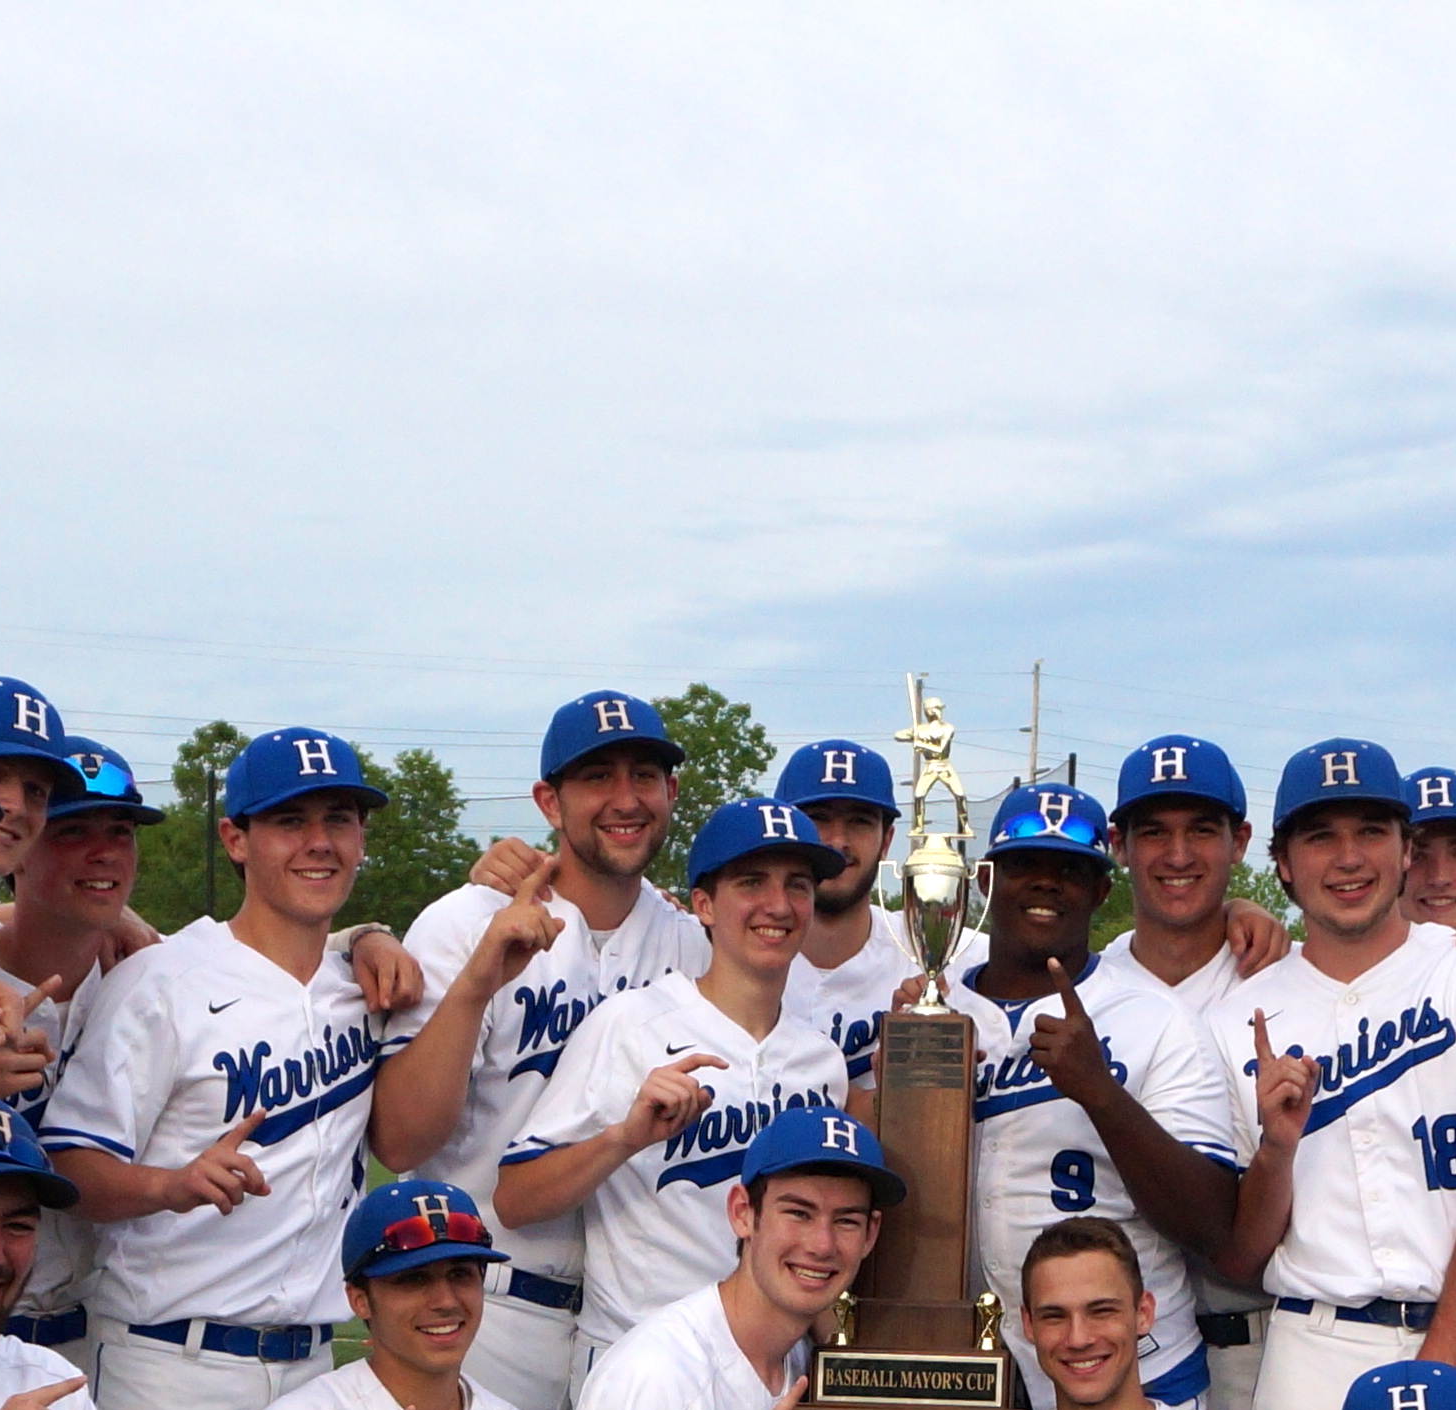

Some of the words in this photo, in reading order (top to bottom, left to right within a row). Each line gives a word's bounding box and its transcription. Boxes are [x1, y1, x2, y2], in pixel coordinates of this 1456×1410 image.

[13, 692, 50, 741] H
[592, 699, 634, 733] H
[293, 739, 338, 776] H
[821, 750, 857, 784] H
[1149, 747, 1187, 783] H
[1322, 751, 1360, 787] H
[1038, 793, 1072, 820] H
[1417, 777, 1454, 810] H
[758, 804, 798, 840] H
[213, 1014, 377, 1123] Warriors
[821, 1117, 859, 1157] H
[1051, 1149, 1095, 1211] 9
[412, 1194, 453, 1230] H
[826, 1369, 897, 1388] BASEBALL
[900, 1371, 964, 1390] MAYOR'S
[966, 1373, 995, 1390] CUP
